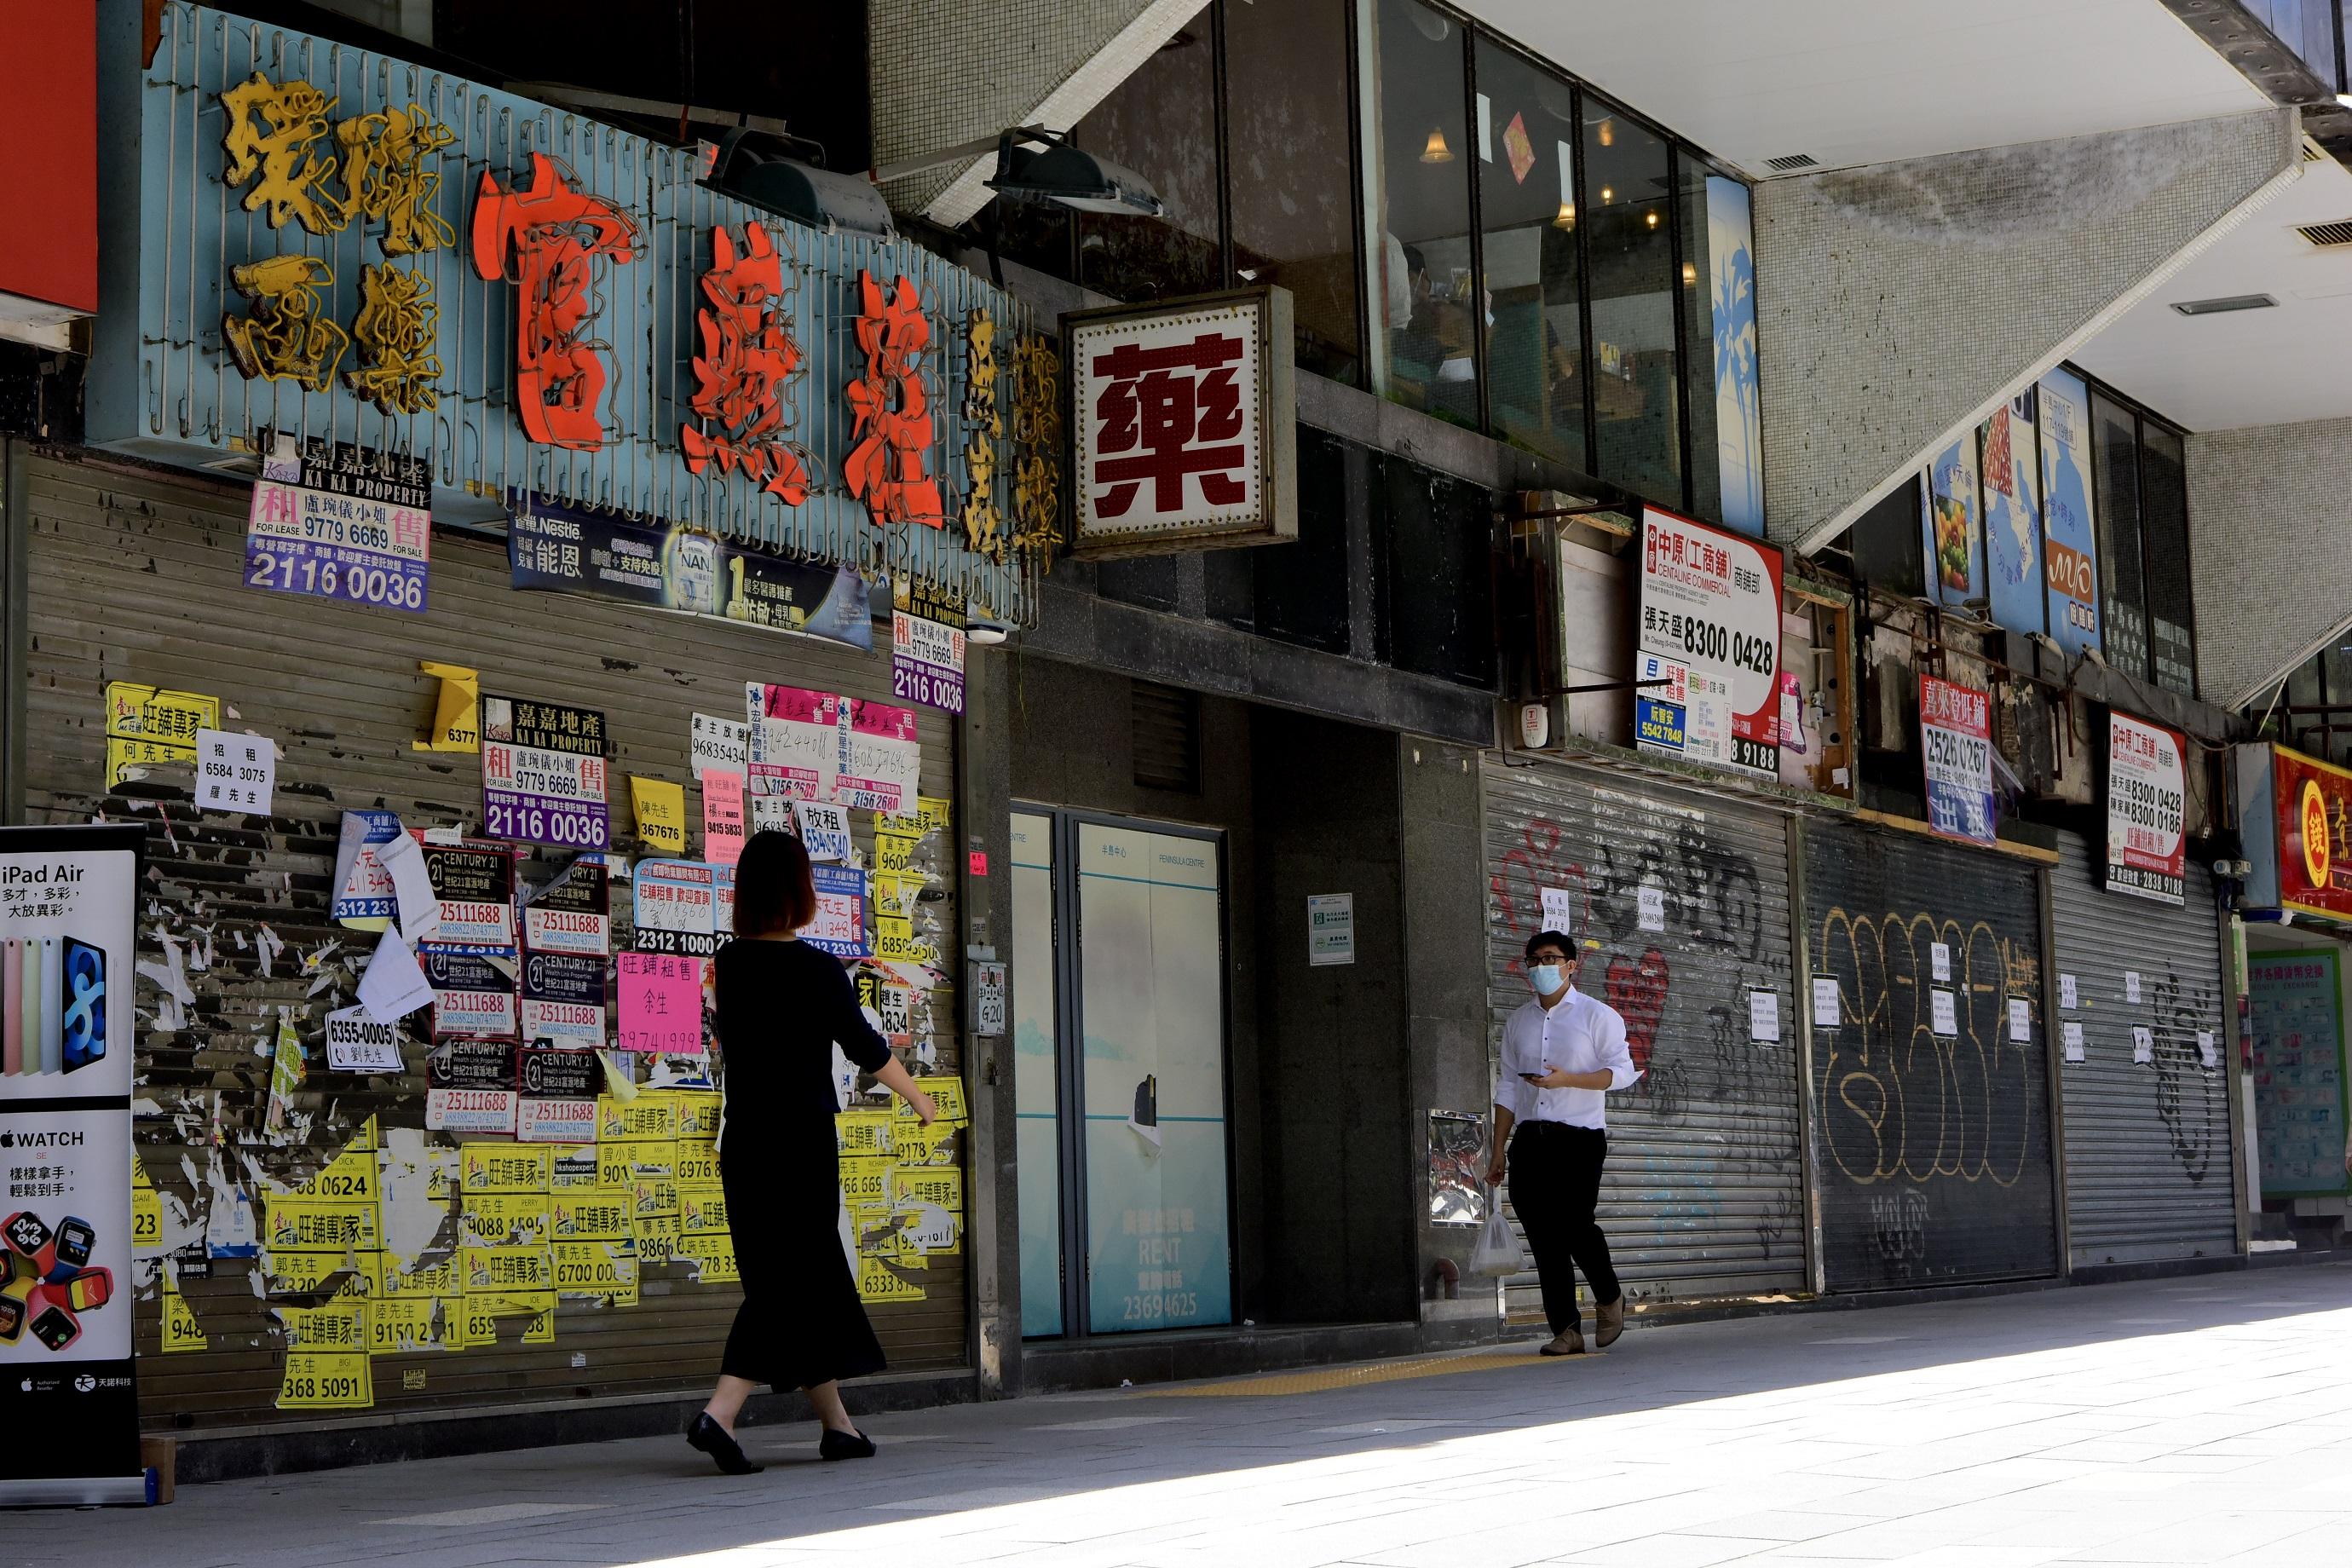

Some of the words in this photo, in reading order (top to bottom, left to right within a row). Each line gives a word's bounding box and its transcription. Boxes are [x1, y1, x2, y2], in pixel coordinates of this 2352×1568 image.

[1092, 332, 1245, 518] 藥
[304, 470, 322, 488] KA
[331, 475, 348, 493] KA
[355, 478, 426, 507] PROPERTY
[259, 486, 298, 524] 租
[256, 522, 274, 533] FOR
[276, 524, 300, 536] LEASE
[305, 516, 343, 541] 9779
[349, 523, 389, 550] 6669
[392, 510, 425, 546] 售
[393, 545, 406, 555] FOR
[407, 547, 423, 557] SALE
[536, 539, 581, 578] 能恩
[682, 553, 711, 573] NAN
[251, 553, 337, 594] 2116
[347, 566, 423, 609] 0036
[1658, 564, 1692, 585] CENTALINE
[1692, 573, 1731, 597] COMMERCIAL
[912, 600, 921, 614] KA
[924, 603, 933, 618] KA
[936, 606, 966, 629] PROPERTY
[1645, 606, 1682, 638] 張天盛
[894, 614, 911, 646] 租
[912, 639, 931, 659] 9779
[932, 644, 951, 665] 6669
[952, 631, 964, 662] 售
[1685, 616, 1727, 662] 8300
[1733, 631, 1773, 676] 0428
[895, 669, 929, 703] 2116
[934, 679, 963, 712] 0036
[142, 703, 201, 740] 旺舖專家
[516, 703, 600, 738] 嘉嘉地產
[693, 718, 747, 741] 業主放盤
[447, 729, 476, 744] 6377
[516, 728, 530, 744] KA
[533, 730, 546, 747] KA
[551, 733, 602, 755] PROPERTY
[751, 710, 763, 764] 宏星物業
[1642, 722, 1663, 740] 5542
[1663, 727, 1682, 743] 7848
[124, 742, 175, 762] 何先生
[214, 743, 256, 761] 招租
[693, 737, 746, 765] 96835434
[838, 723, 848, 775] 宏星物業
[1744, 742, 1774, 770] 9188
[1927, 729, 1957, 767] 2526
[1960, 738, 1986, 775] 0267
[487, 745, 511, 778] 租
[205, 763, 233, 778] 6584
[239, 767, 265, 782] 3075
[579, 758, 602, 792] 售
[487, 778, 497, 787] FOR
[498, 779, 512, 789] LEASE
[516, 770, 545, 791] 9779
[549, 775, 577, 796] 6669
[771, 779, 793, 794] 3156
[210, 786, 257, 804] 羅先生
[591, 792, 602, 800] SALE
[853, 792, 874, 806] 3156
[876, 797, 898, 810] 2680
[2132, 780, 2155, 806] 8300
[2159, 787, 2182, 813] 0428
[641, 801, 669, 819] 陳先生
[805, 807, 840, 830] 放租
[2131, 802, 2155, 828] 8300
[2158, 810, 2181, 835] 0186
[488, 804, 543, 839] 2116
[551, 814, 605, 846] 0036
[641, 822, 679, 840] 367676
[707, 822, 723, 834] 9415
[725, 824, 742, 836] 5833
[444, 853, 487, 868] CENTURY
[490, 856, 498, 869] 21
[1102, 845, 1127, 858] 半島中心
[1159, 855, 1185, 866] PENINSULA
[1185, 857, 1205, 868] CENTRE
[3, 865, 48, 884] iPad
[55, 865, 84, 883] Air
[432, 864, 442, 881] 21
[640, 885, 673, 902] 旺舖租售
[2143, 871, 2162, 891] 2838
[2164, 876, 2182, 896] 9188
[441, 903, 499, 923] 25111688
[544, 912, 599, 933] 25111688
[638, 931, 674, 950] 2312
[680, 935, 714, 954] 1000
[832, 943, 861, 955] 2319
[545, 955, 584, 971] CENTURY
[588, 960, 596, 972] 21
[858, 978, 873, 1007] 家
[2283, 980, 2320, 990] EXCHANGE
[444, 993, 505, 1013] 25111688
[539, 1004, 597, 1025] 25111688
[983, 1004, 1002, 1023] G20
[331, 1020, 393, 1046] 6355-0005
[350, 1047, 385, 1064] 劉先生
[452, 1041, 495, 1057] CENTURY
[498, 1043, 505, 1056] 21
[541, 1053, 582, 1067] CENTURY
[585, 1055, 593, 1067] 21
[447, 1091, 508, 1111] 25111688
[535, 1103, 594, 1121] 25111688
[624, 1108, 667, 1134] 旺舖專家
[17, 1131, 84, 1148] WATCH
[603, 1146, 637, 1162] 曾小姐
[678, 1144, 711, 1158] 李先生
[338, 1157, 355, 1166] DICK
[679, 1161, 711, 1179] 6976
[489, 1158, 538, 1186] 旺舖專家
[321, 1176, 367, 1196] 0624
[468, 1217, 504, 1237] 9088
[575, 1207, 620, 1233] 旺舖專家
[557, 1245, 592, 1260] 黃先生
[1139, 1238, 1182, 1265] RENT
[275, 1257, 318, 1273] 郭先生
[491, 1256, 540, 1284] 旺舖專家
[559, 1264, 591, 1282] 6700
[865, 1275, 894, 1293] 6333
[375, 1303, 414, 1319] 陸先生
[298, 1315, 353, 1345] 旺舖專家
[289, 1358, 315, 1374] 先生
[321, 1377, 358, 1398] 5091
